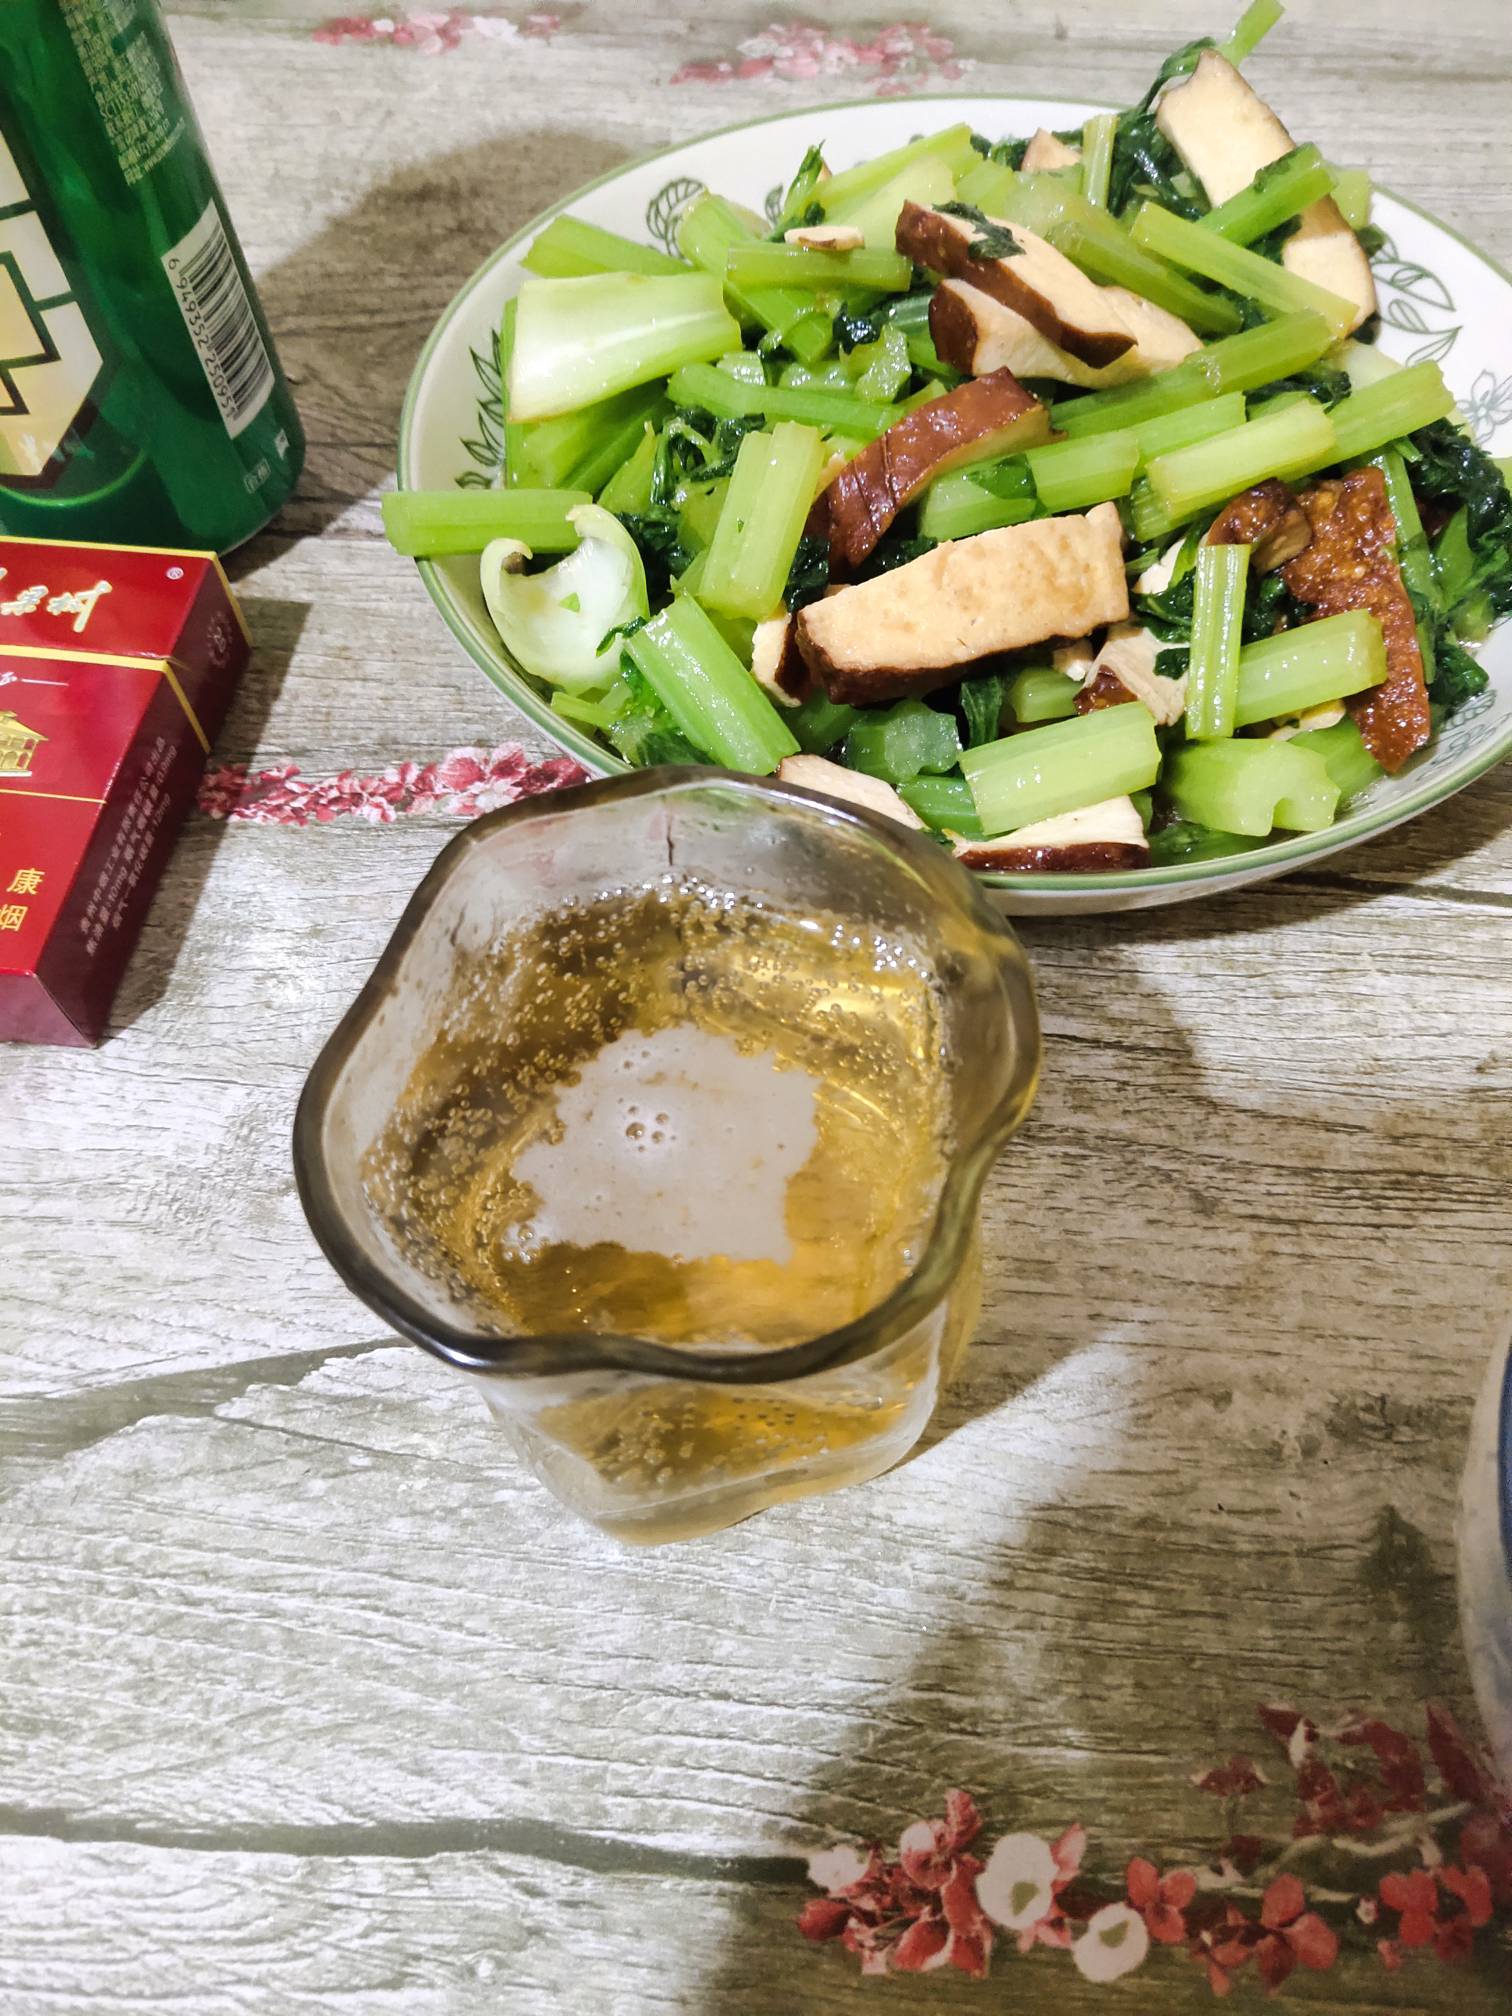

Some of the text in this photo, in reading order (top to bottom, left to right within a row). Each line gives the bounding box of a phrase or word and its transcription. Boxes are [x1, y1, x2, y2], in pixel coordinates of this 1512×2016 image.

[168, 257, 238, 419] 6 949352 250951
[6, 867, 45, 895] 康
